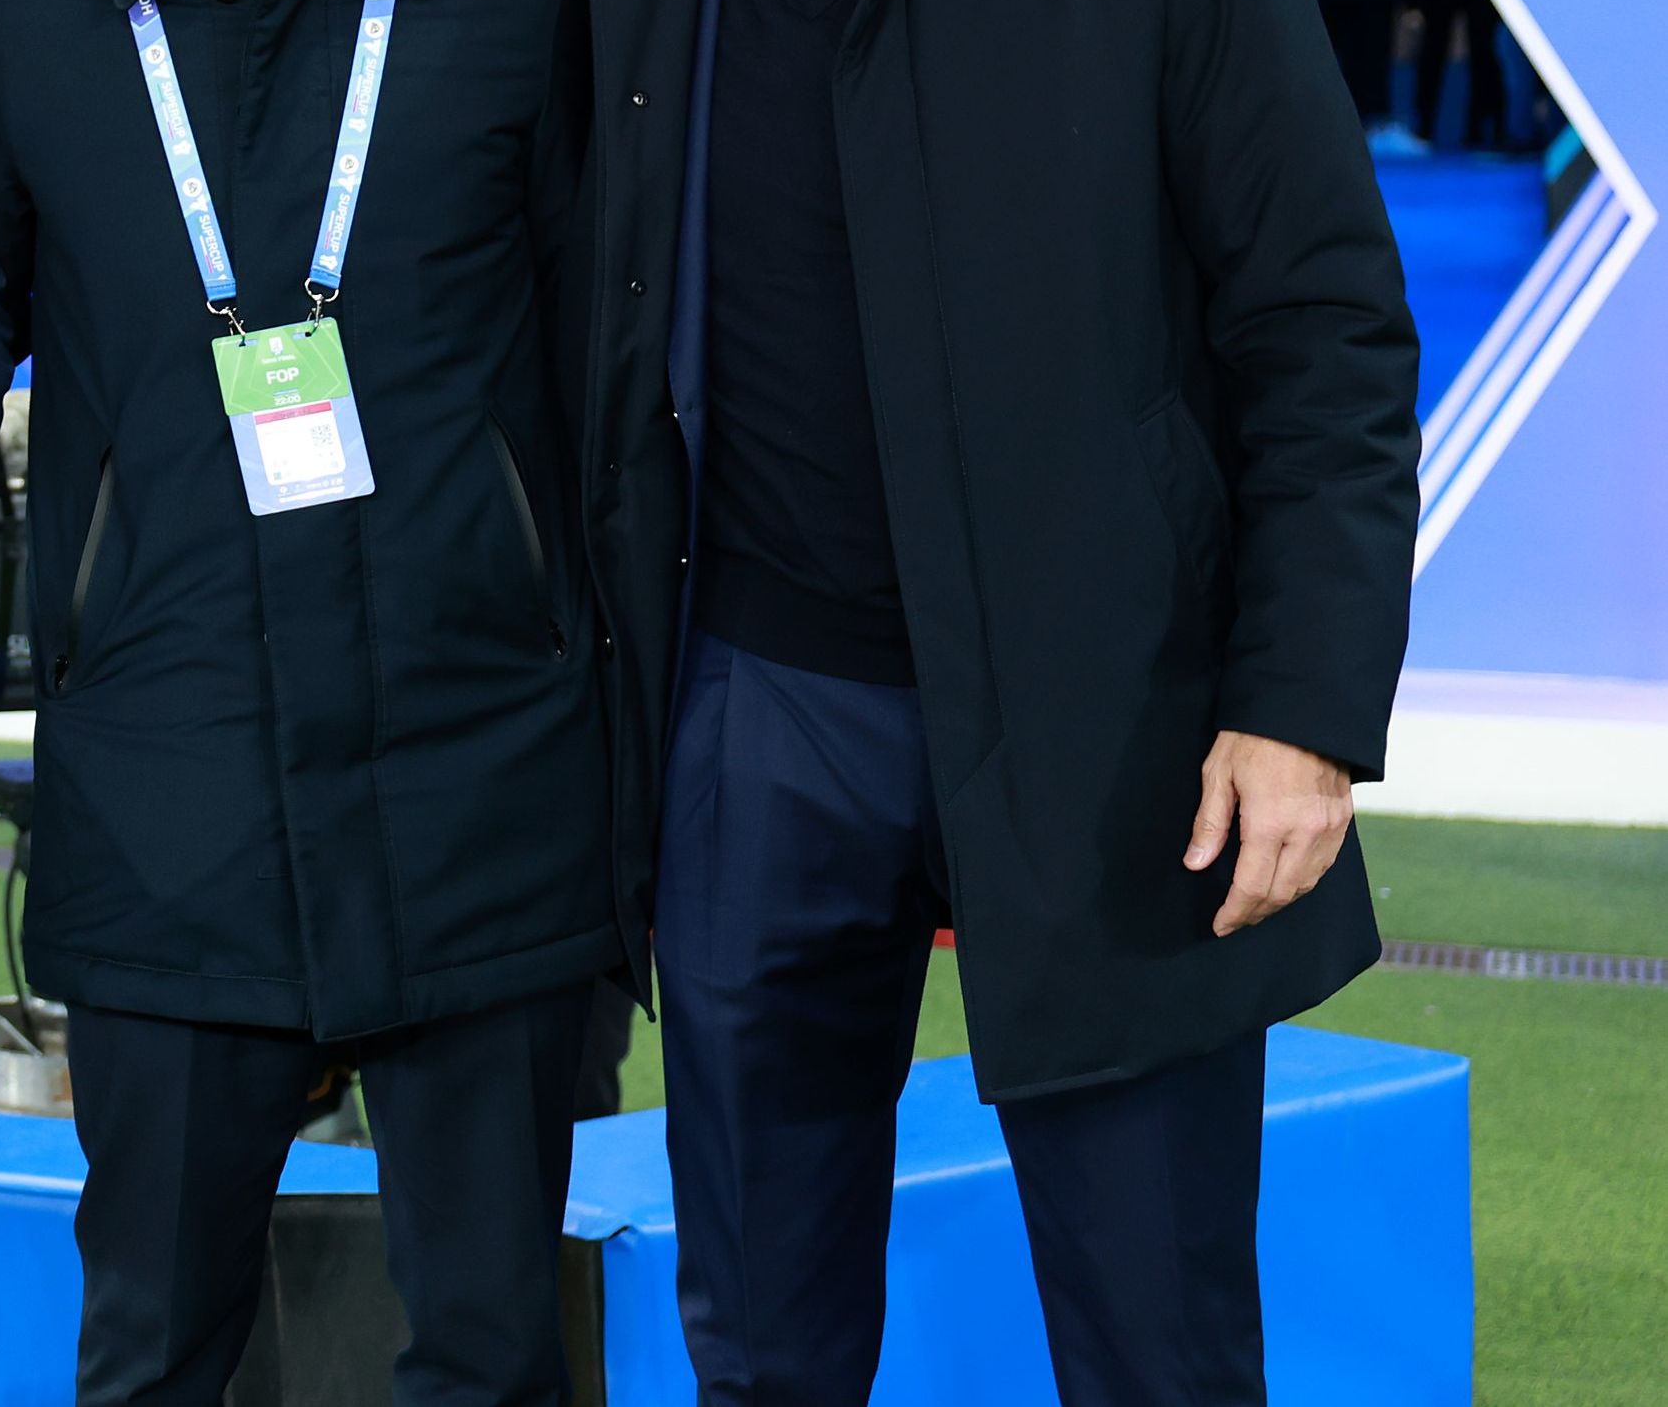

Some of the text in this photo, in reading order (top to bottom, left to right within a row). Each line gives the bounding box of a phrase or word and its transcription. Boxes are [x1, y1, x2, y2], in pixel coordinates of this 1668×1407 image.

[162, 81, 186, 138] SUPERCUP
[359, 58, 377, 116] SUPERCUP
[199, 214, 224, 272] SUPERCUP
[330, 193, 351, 253] SUPERCUP
[266, 367, 299, 385] FOP
